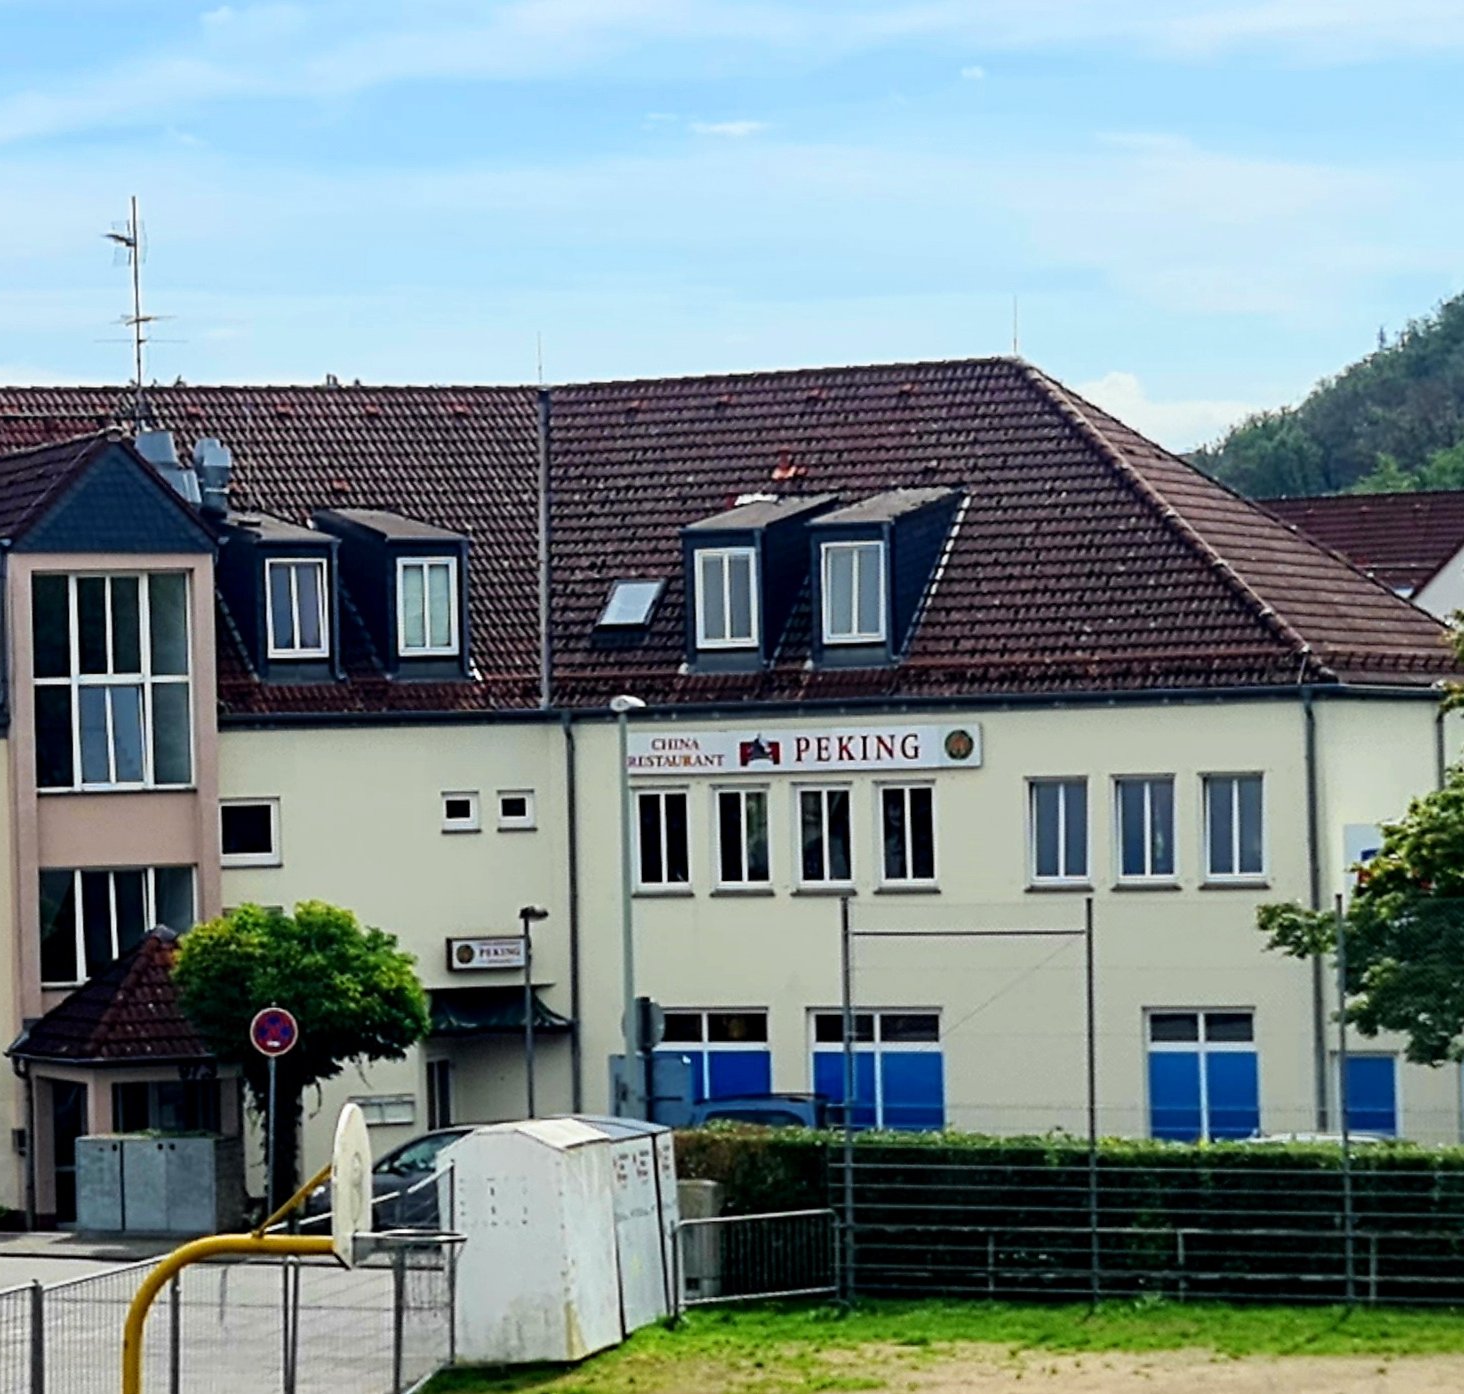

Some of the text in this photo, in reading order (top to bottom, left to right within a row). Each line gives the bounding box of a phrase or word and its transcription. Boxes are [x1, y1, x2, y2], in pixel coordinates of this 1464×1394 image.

[650, 736, 700, 752] CHINA
[794, 733, 921, 763] PEKING
[628, 754, 724, 769] RESTAURANT
[479, 947, 521, 957] PEKING
